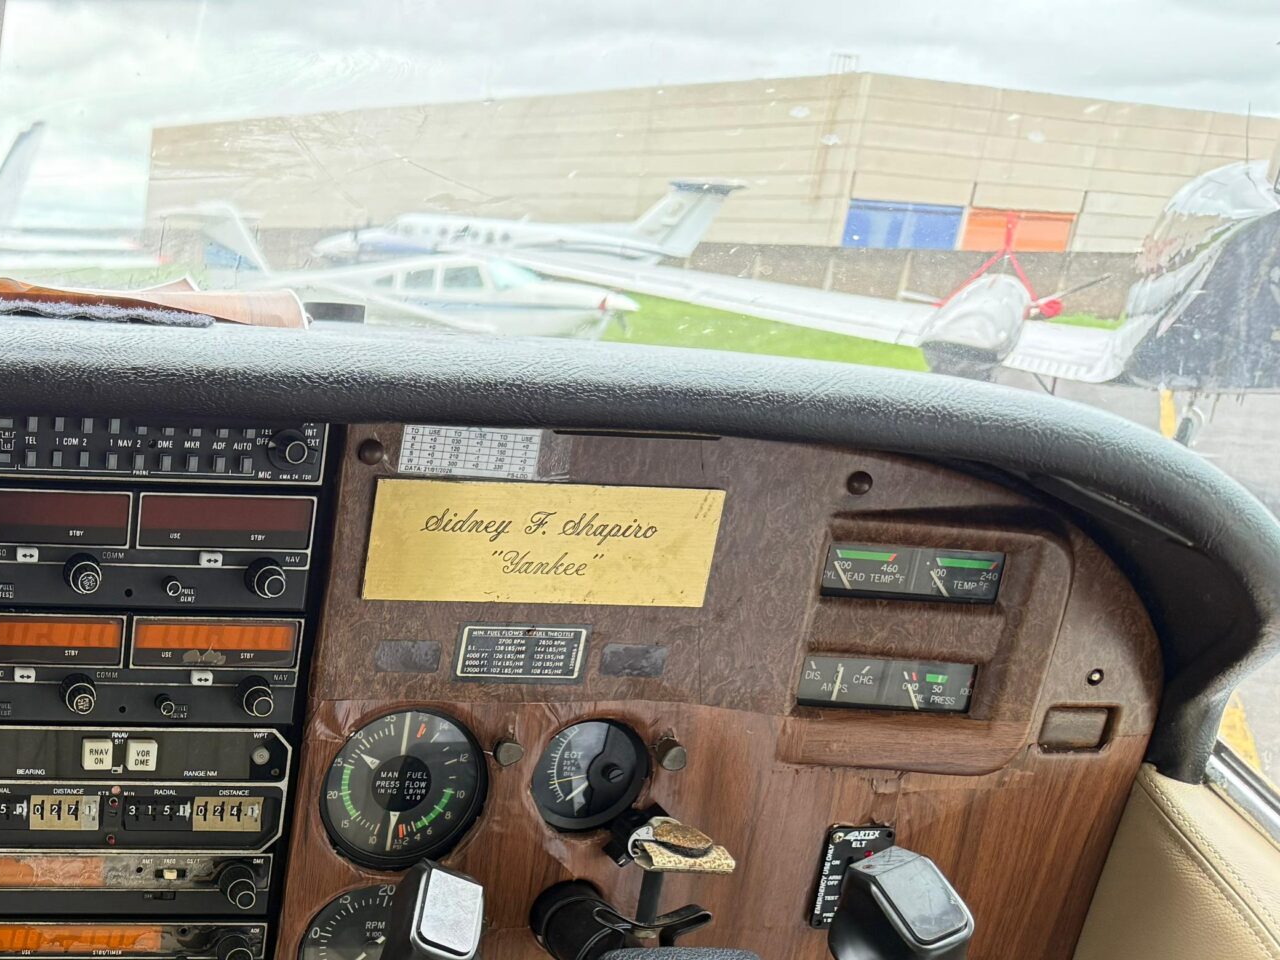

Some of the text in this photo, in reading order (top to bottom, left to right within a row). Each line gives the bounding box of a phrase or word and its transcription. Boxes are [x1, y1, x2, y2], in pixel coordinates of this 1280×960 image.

[25, 437, 252, 451] TEL COM NAV DME MKR ADF AUTO
[420, 508, 658, 545] Sidney F. Shapiro
[102, 551, 124, 559] COMM
[492, 550, 605, 576] "Yankee"
[869, 573, 893, 583] TEMP
[930, 695, 956, 705] PRESS
[564, 751, 583, 759] EGT
[407, 771, 427, 779] FUEL
[851, 830, 880, 838] ARTEX
